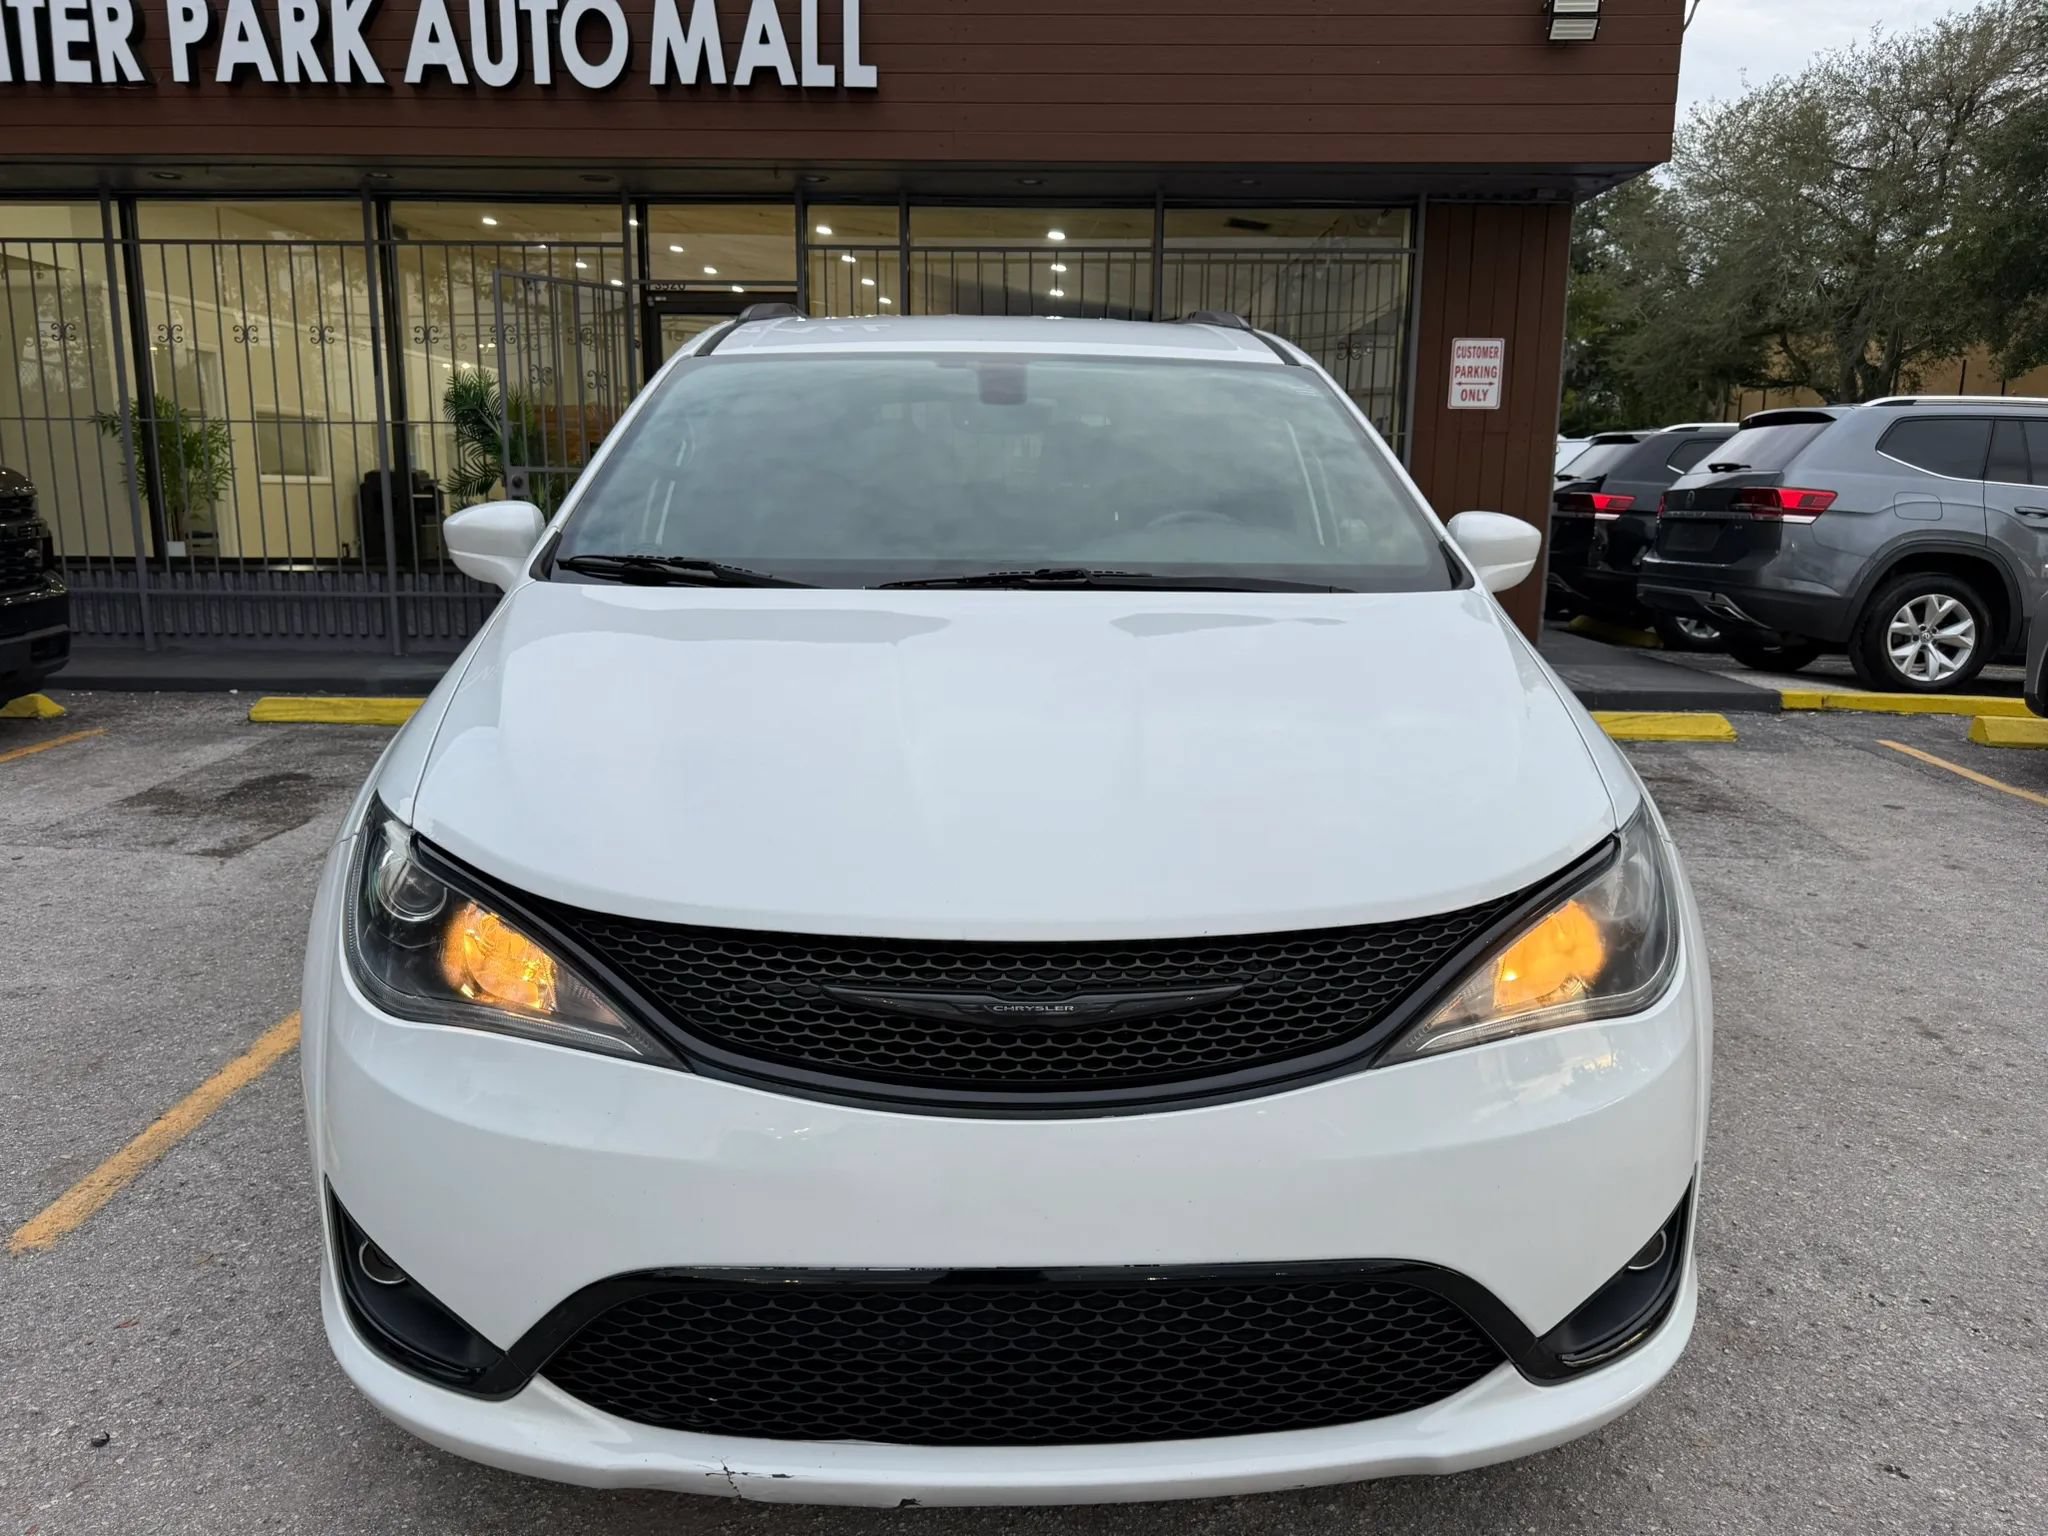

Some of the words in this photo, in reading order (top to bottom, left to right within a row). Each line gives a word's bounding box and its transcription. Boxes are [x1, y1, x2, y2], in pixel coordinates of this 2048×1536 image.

[0, 0, 145, 83] TER
[167, 0, 385, 83] PARK
[404, 0, 629, 89] AUTO
[650, 0, 877, 88] MALL
[1456, 346, 1499, 359] CUSTOMER
[1455, 366, 1497, 378] PARKING
[1461, 389, 1489, 401] ONLY
